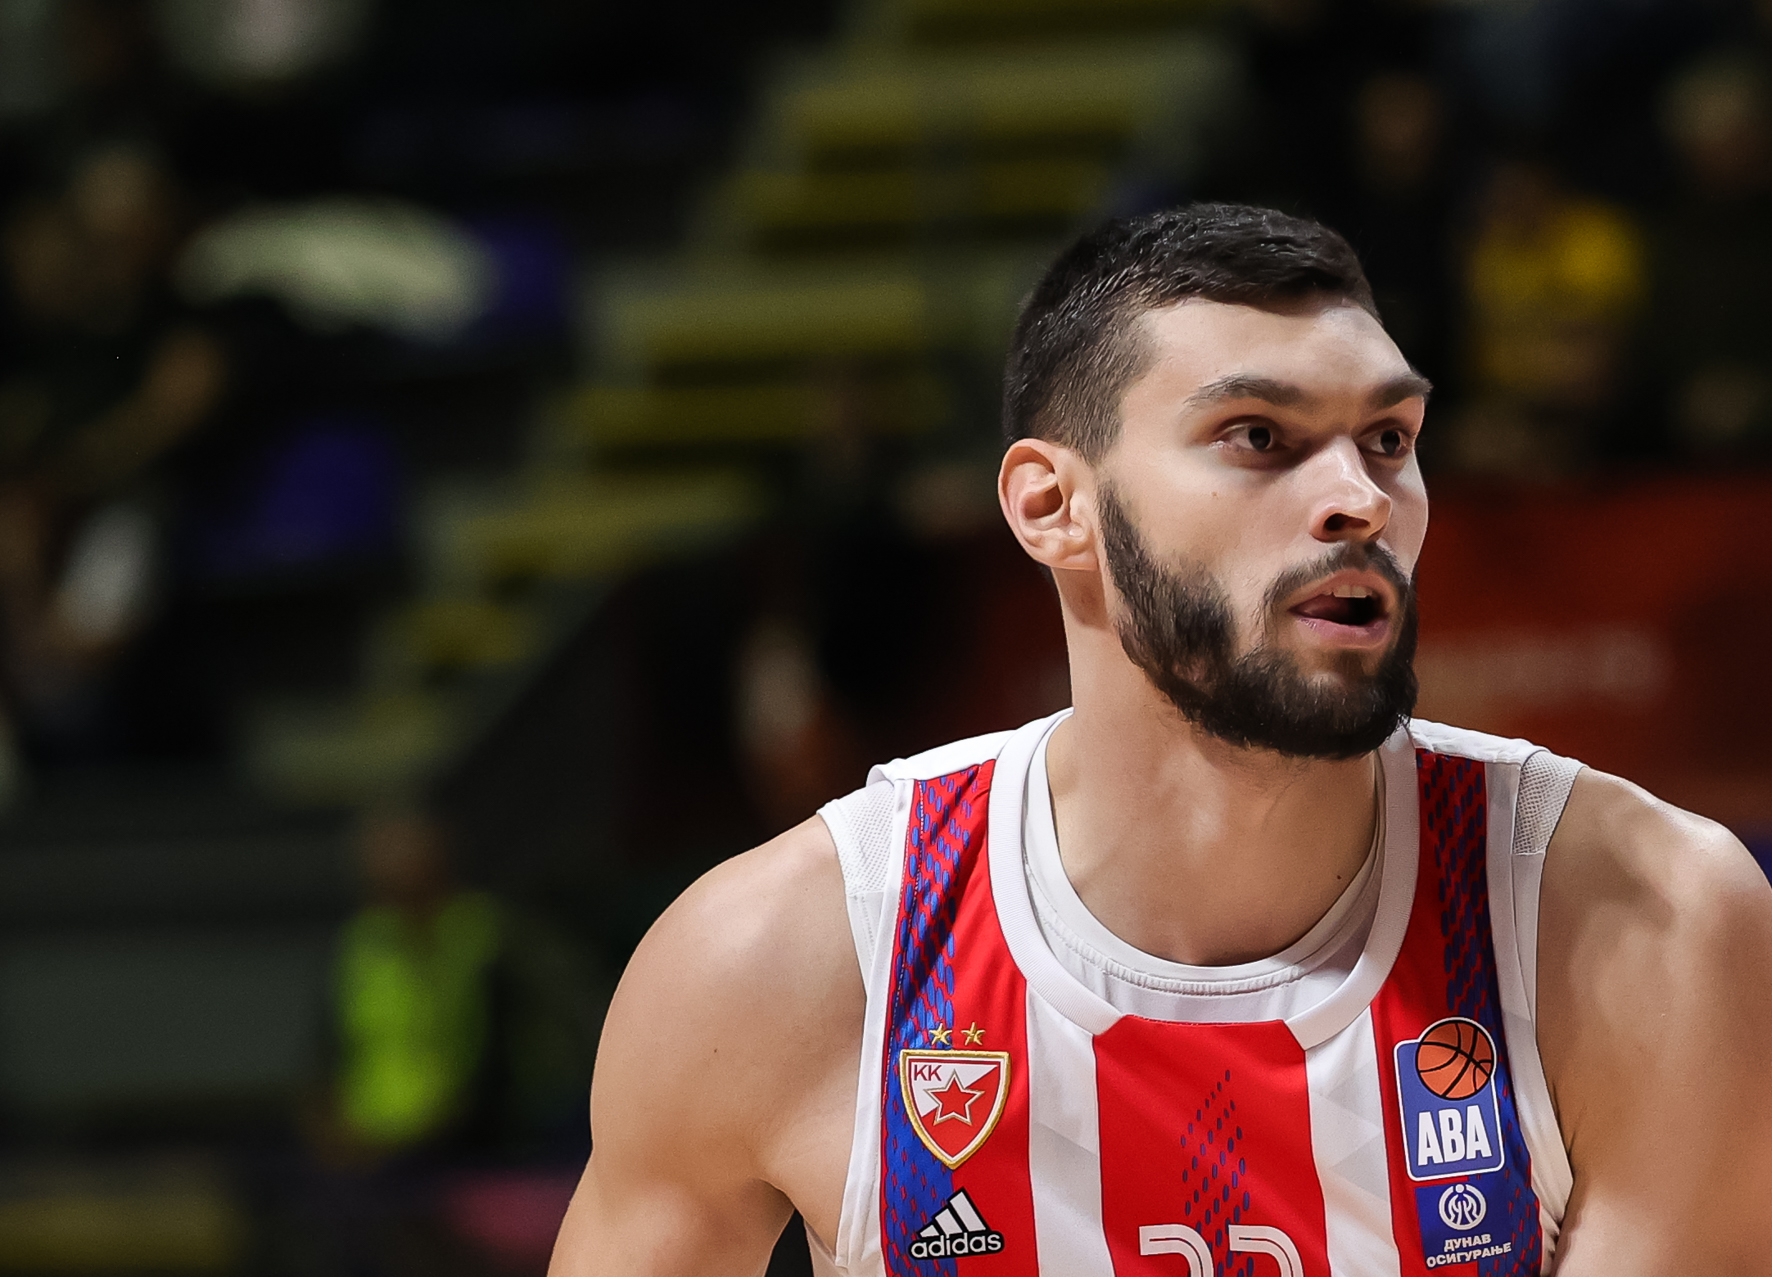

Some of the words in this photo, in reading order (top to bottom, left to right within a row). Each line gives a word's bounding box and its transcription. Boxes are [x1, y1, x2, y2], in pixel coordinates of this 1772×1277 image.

[914, 1064, 942, 1082] KK
[1418, 1105, 1492, 1166] ABA
[910, 1231, 1001, 1258] adidas
[1426, 1242, 1512, 1268] ОСИГУРАЊЕ
[1443, 1233, 1492, 1252] ДУНАВ
